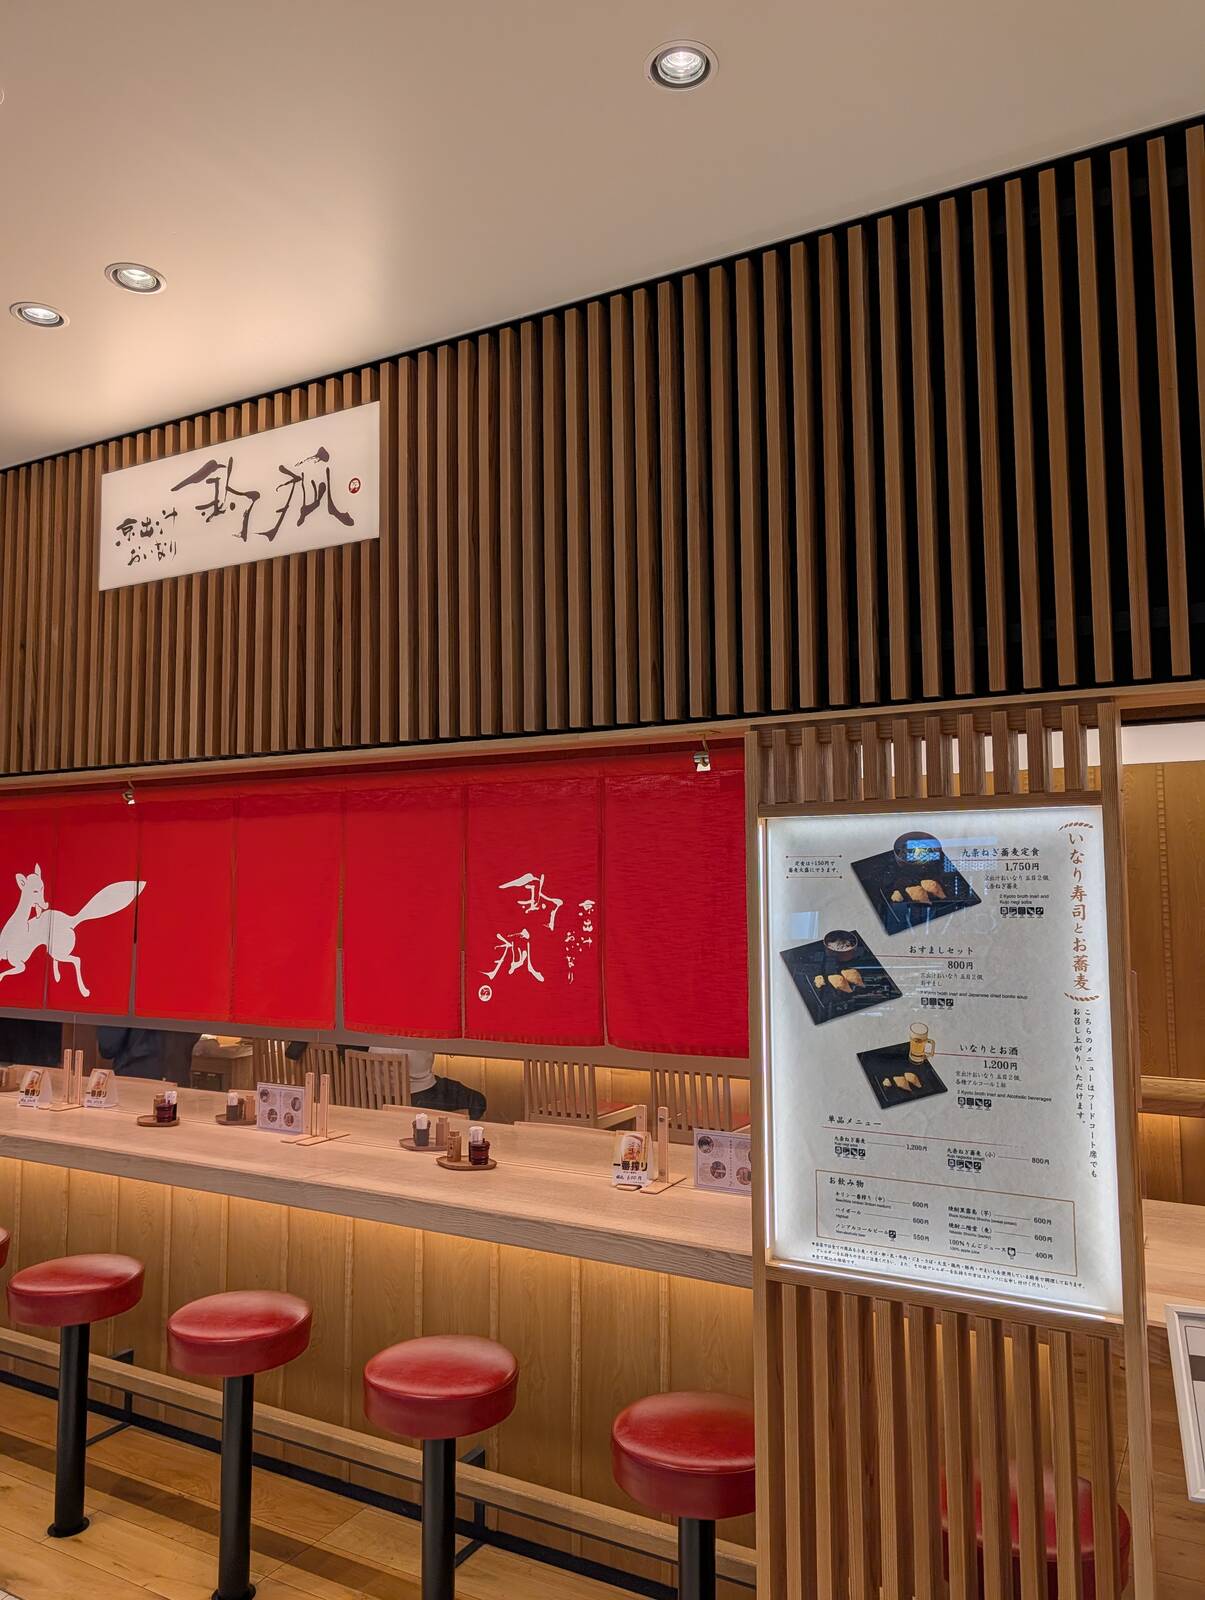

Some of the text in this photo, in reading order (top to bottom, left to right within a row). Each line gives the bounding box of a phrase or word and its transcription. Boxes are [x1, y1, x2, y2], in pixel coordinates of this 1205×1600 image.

[962, 847, 1040, 857] 九条ねぎ蕎麦定食
[1004, 862, 1040, 872] 1,750円
[1068, 832, 1091, 991] いなり寿司とお蕎麦
[909, 945, 974, 955] おすましセット
[947, 961, 973, 970] 800円
[960, 1044, 1018, 1056] いなりとお酒
[983, 1060, 1018, 1071] 1,200円
[1073, 1008, 1086, 1124] お召し上がりいただけます。
[1084, 1008, 1098, 1178] こちらのメニューはフードコート席でも
[828, 1115, 881, 1126] 単品メニュー
[905, 1144, 928, 1152] 1,200円
[613, 1160, 648, 1171] 一番搾り
[1031, 1157, 1050, 1165] 800円
[829, 1177, 864, 1188] お飲み物
[912, 1201, 929, 1209] 600円
[912, 1217, 929, 1225] 600円
[1033, 1217, 1052, 1225] 600円
[912, 1234, 930, 1242] 550円
[1034, 1235, 1053, 1243] 600円
[1035, 1252, 1054, 1260] 400円
